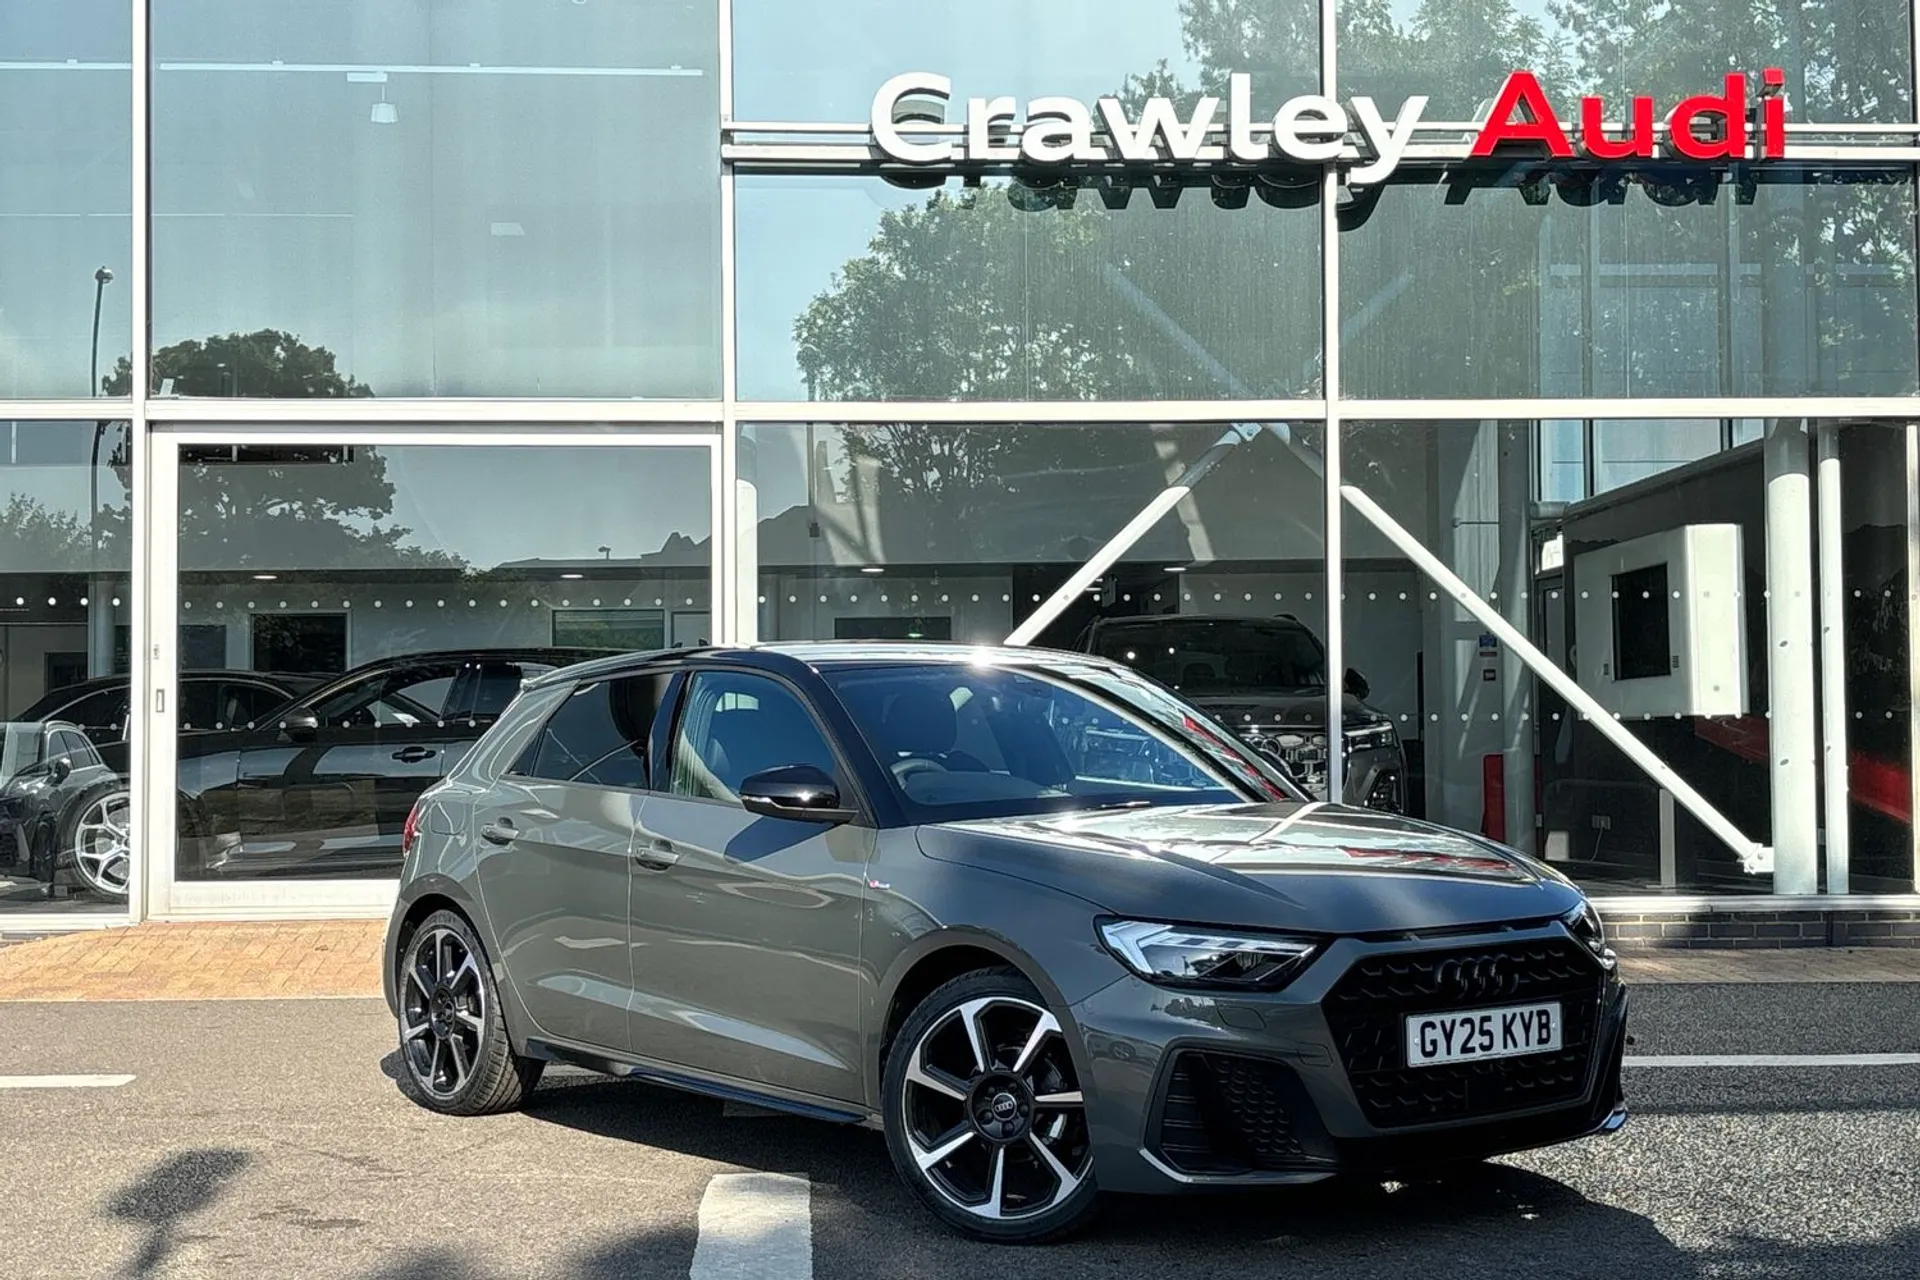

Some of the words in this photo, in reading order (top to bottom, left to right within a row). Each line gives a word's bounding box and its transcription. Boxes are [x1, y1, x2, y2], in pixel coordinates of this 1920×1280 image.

[870, 71, 1430, 185] Crawley
[1470, 67, 1786, 159] Audi
[1419, 1015, 1494, 1058] GY25
[1502, 1009, 1551, 1050] KYB
